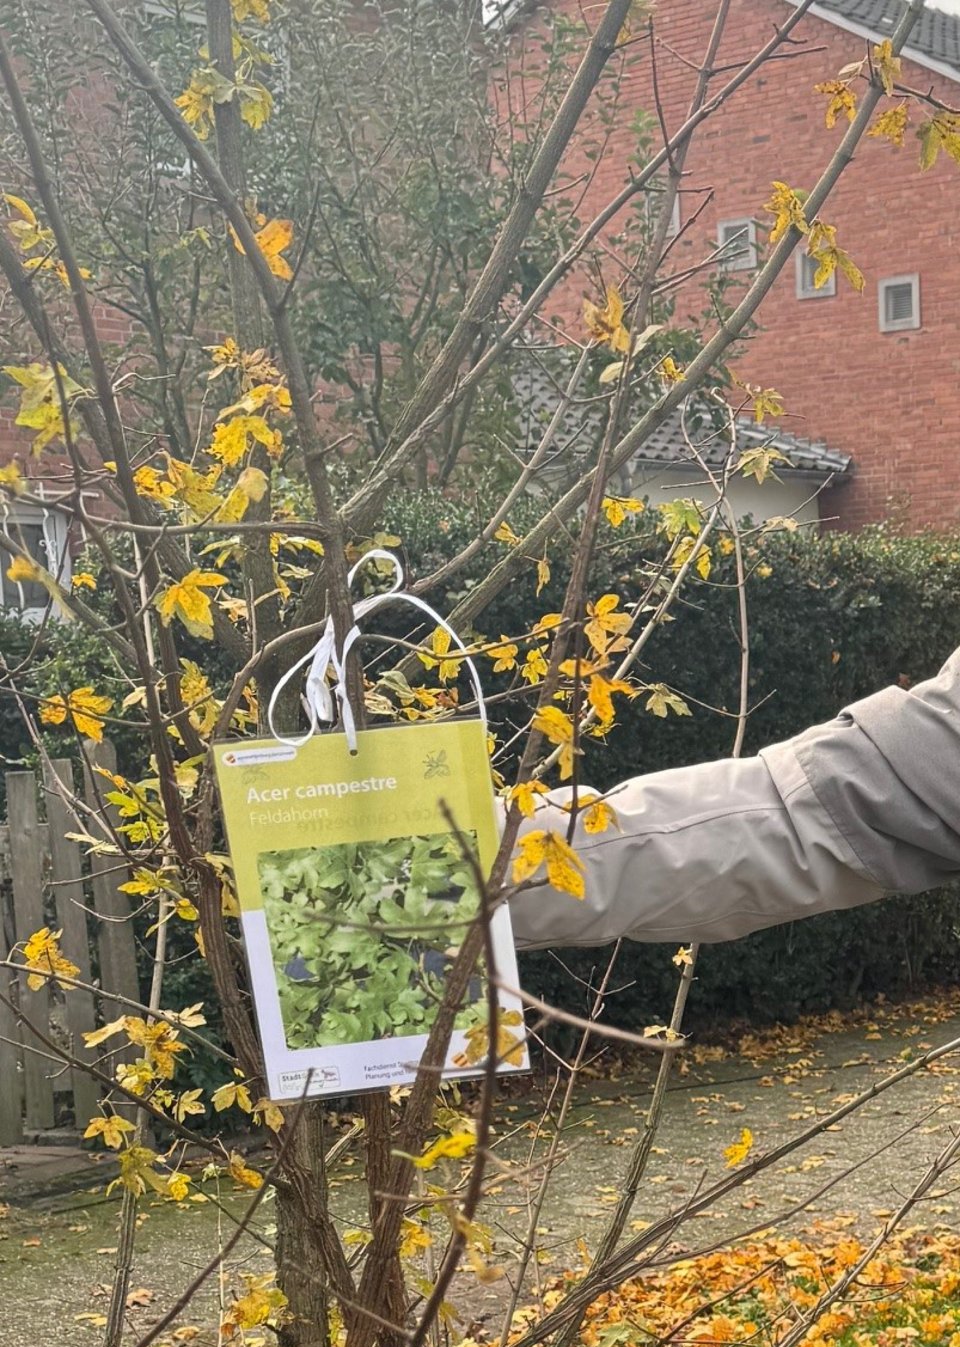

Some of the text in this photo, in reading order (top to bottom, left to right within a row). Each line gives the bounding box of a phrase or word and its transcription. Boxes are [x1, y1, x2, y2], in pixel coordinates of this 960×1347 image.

[247, 776, 398, 804] Acer campestre
[249, 807, 329, 827] Feldahorn
